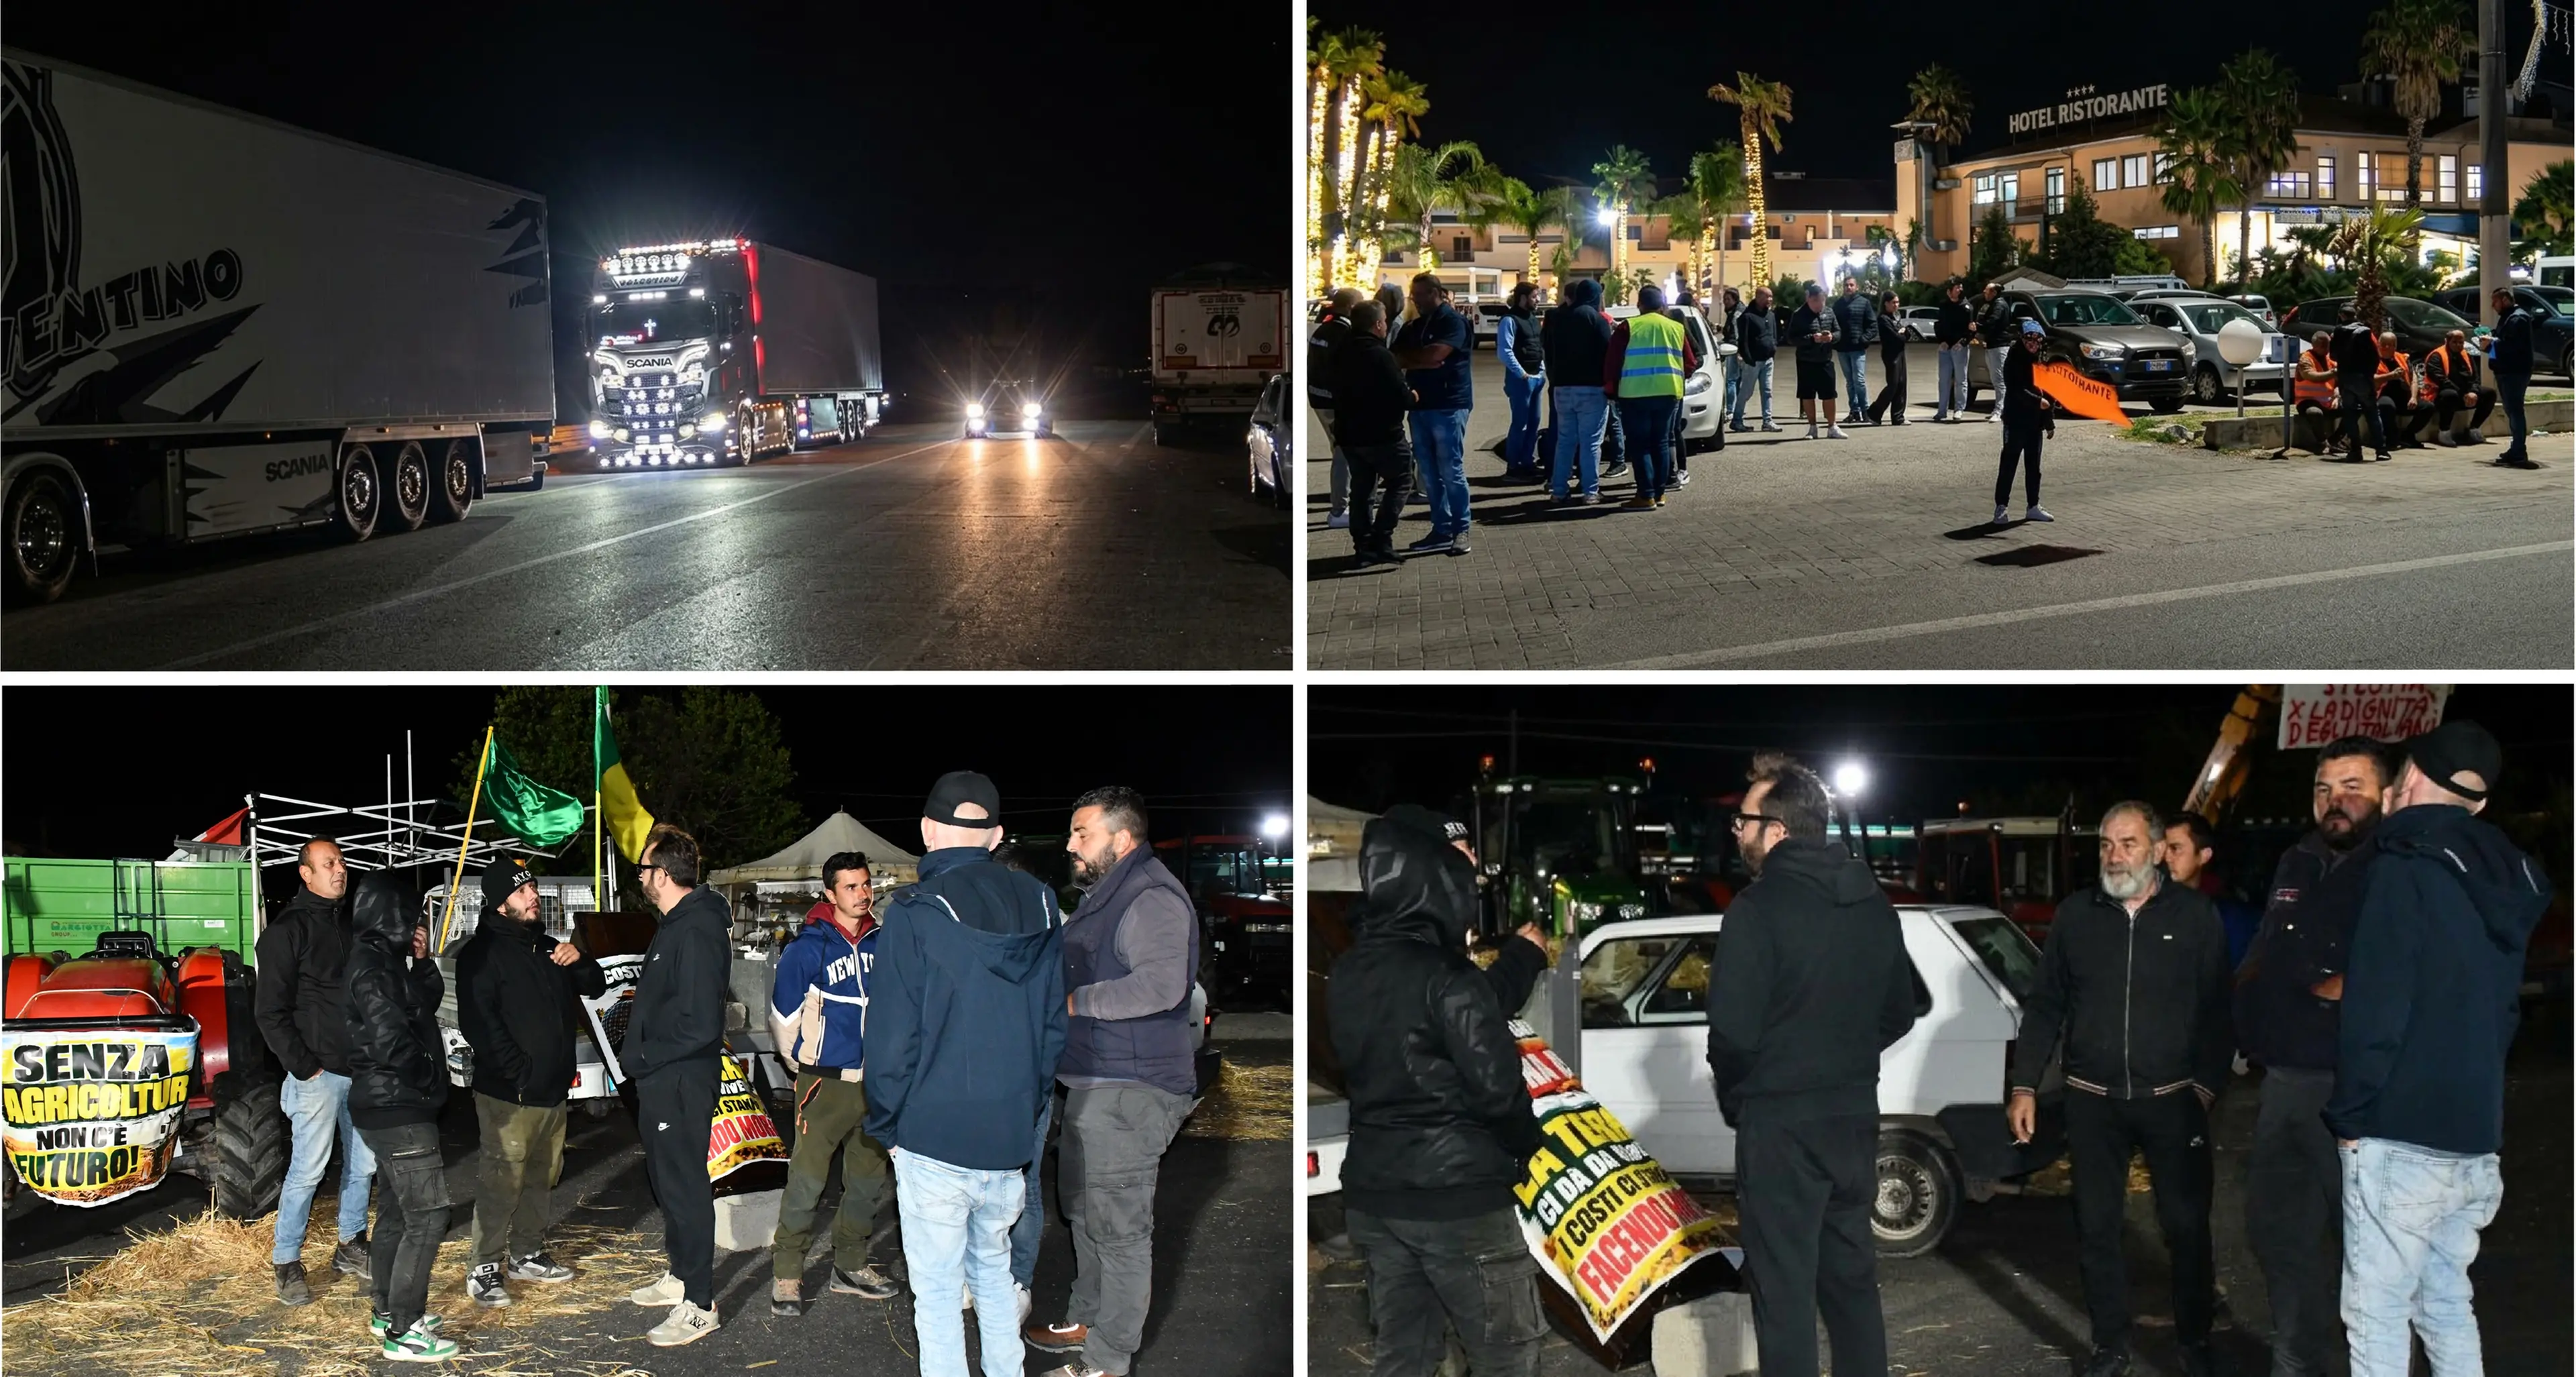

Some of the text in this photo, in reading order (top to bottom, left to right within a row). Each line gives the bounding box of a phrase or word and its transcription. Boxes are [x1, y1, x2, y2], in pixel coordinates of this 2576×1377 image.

[2009, 83, 2167, 133] HOTEL RISTORANTE
[1, 247, 243, 384] ENTINO
[627, 357, 673, 368] SCANIA
[266, 453, 329, 482] SCANIA
[2287, 700, 2306, 721] X
[604, 965, 643, 985] COST
[826, 954, 855, 986] NEW
[13, 1043, 171, 1083] SENZA
[36, 1123, 127, 1151] NON C'È
[707, 1118, 741, 1161] NDO
[15, 1146, 140, 1188] FUTURO!
[1513, 1146, 1566, 1210] LA
[1617, 1173, 1643, 1197] CI
[1537, 1189, 1565, 1226] CI
[1583, 1150, 1621, 1178] DA
[1565, 1185, 1624, 1247] COSTI
[1558, 1237, 1574, 1260] I
[1576, 1196, 1681, 1306] FACENDO
